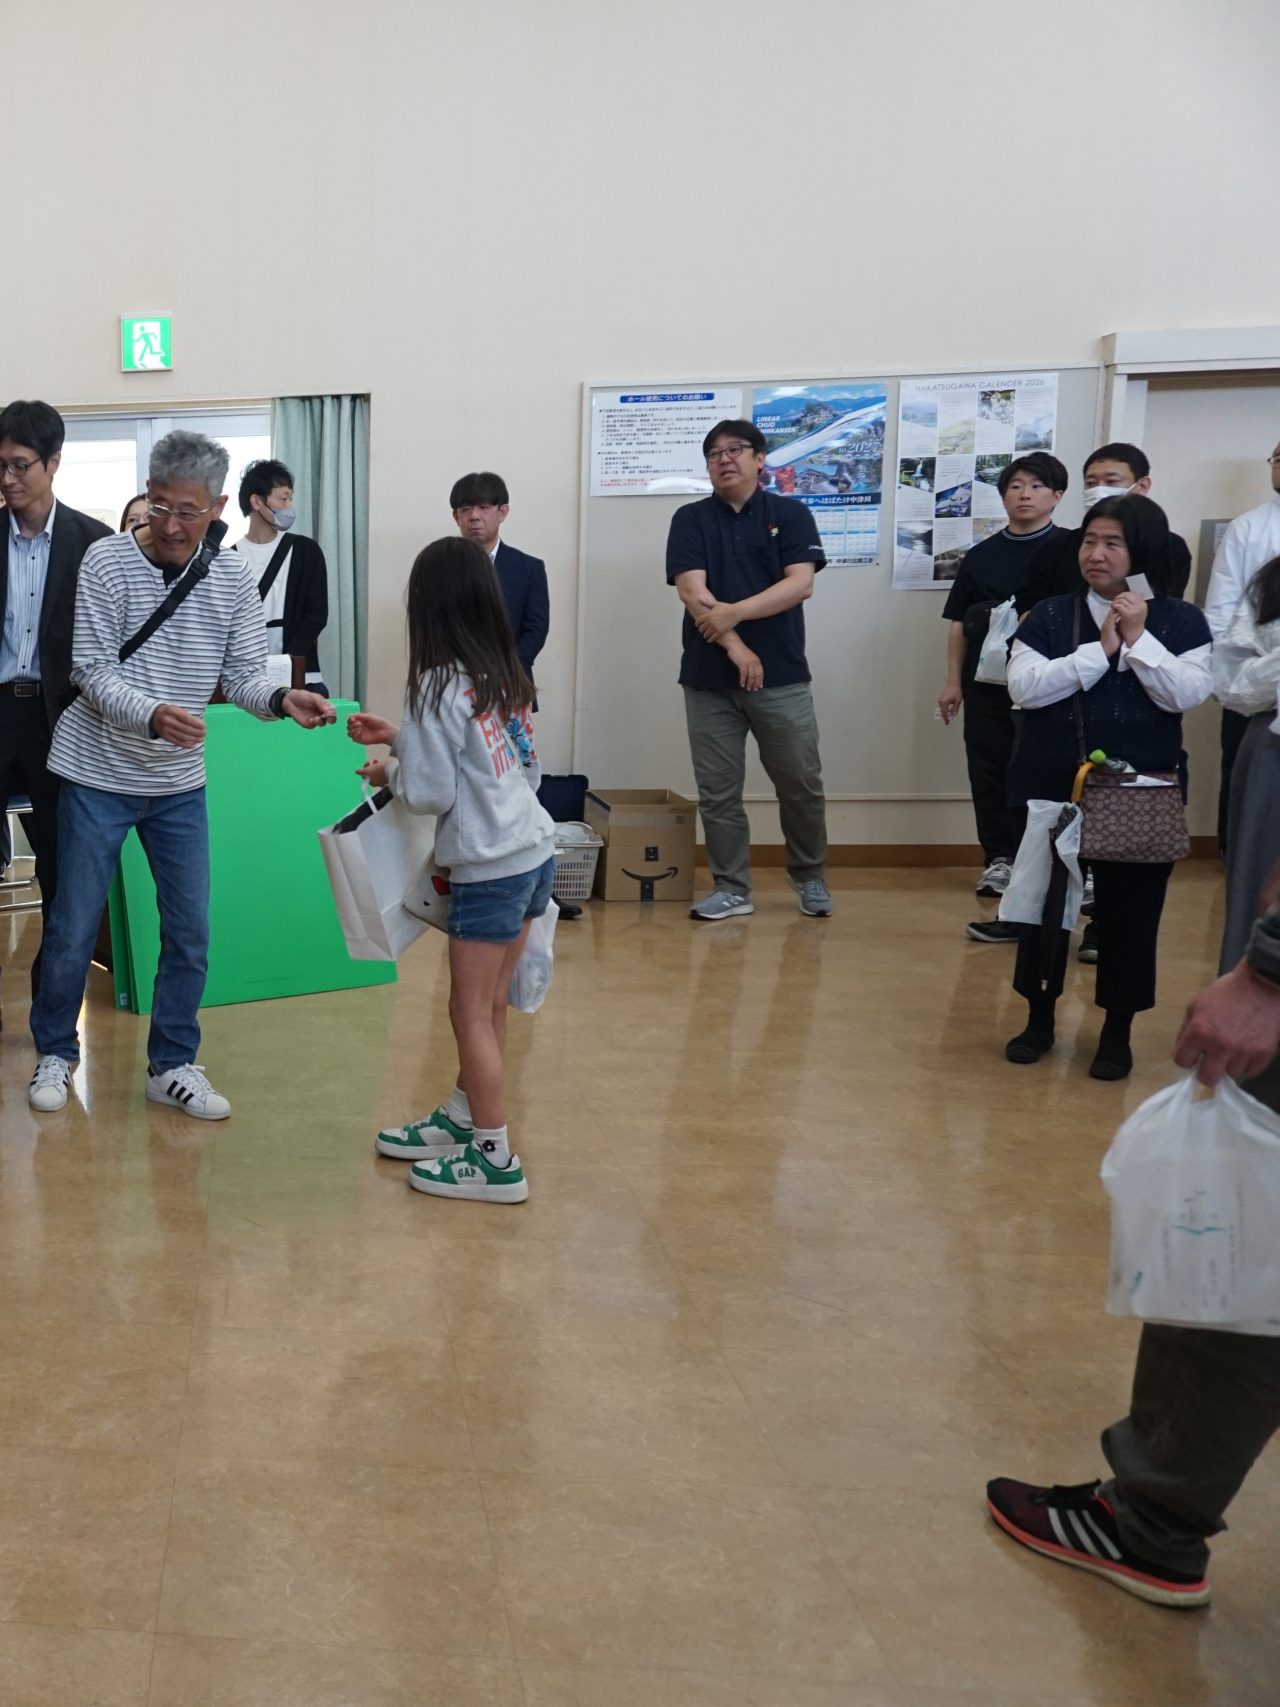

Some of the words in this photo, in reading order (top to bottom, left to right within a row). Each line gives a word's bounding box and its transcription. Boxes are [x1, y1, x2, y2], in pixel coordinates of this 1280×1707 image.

[1025, 378, 1045, 387] 2026
[627, 393, 707, 402] ホール使用についてのお願い
[847, 440, 880, 453] 2027
[458, 1167, 476, 1179] GAP
